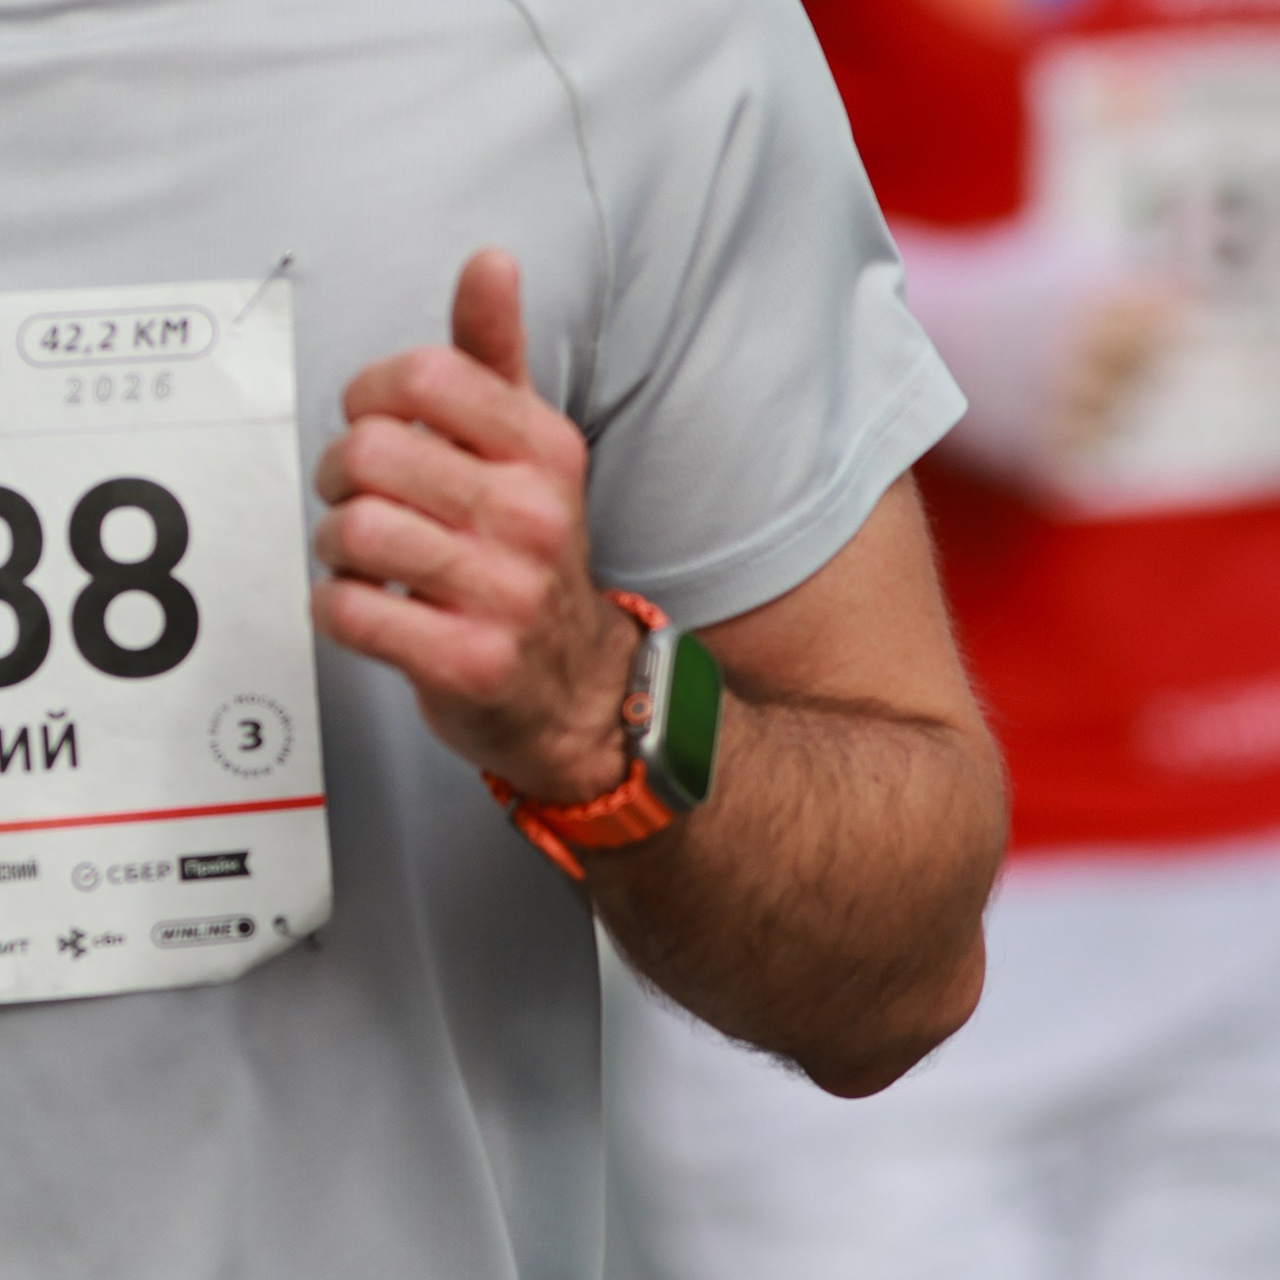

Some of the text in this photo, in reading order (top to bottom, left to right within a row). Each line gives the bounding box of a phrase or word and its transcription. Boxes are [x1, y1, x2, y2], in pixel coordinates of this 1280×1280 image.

[40, 317, 190, 354] 42,2 КМ
[64, 371, 172, 405] 2026
[107, 860, 172, 884] СБЕР
